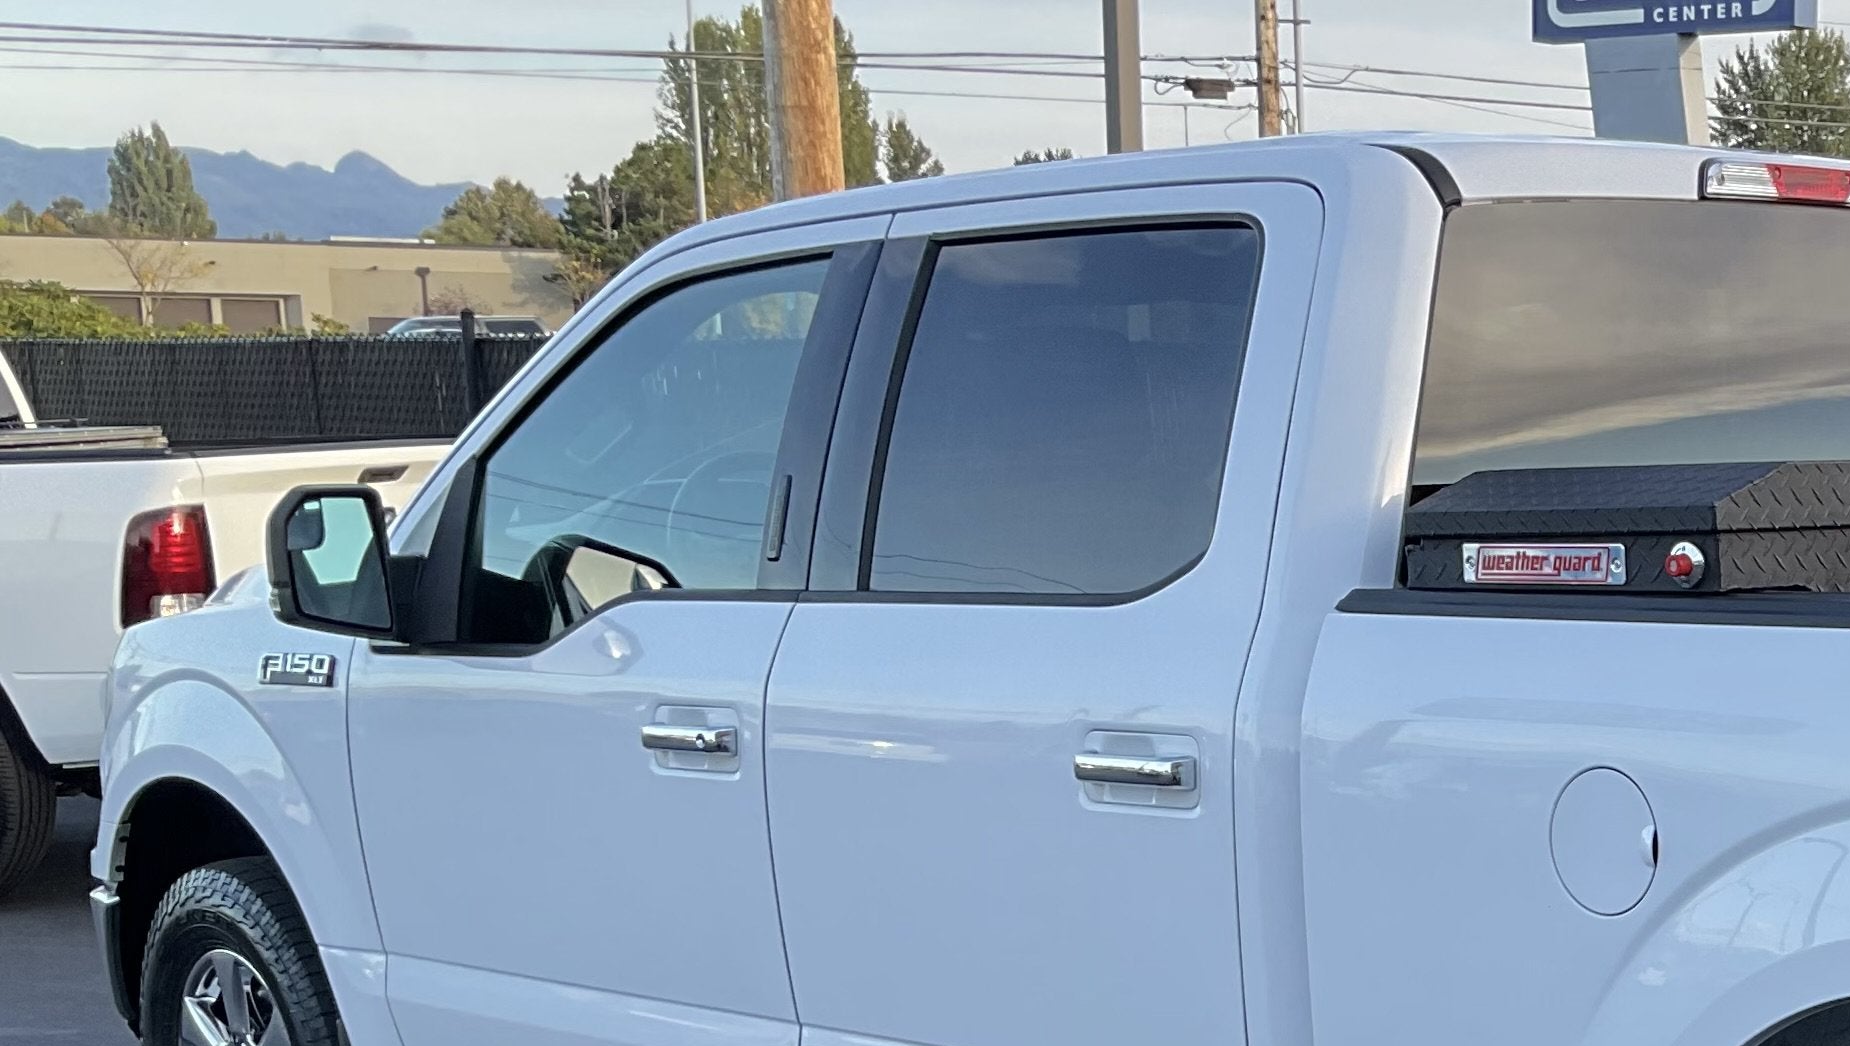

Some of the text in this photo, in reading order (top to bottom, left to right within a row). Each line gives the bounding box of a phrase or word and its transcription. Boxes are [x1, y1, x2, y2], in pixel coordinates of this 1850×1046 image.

[1652, 3, 1743, 23] CENTER
[1482, 551, 1603, 575] weather guard
